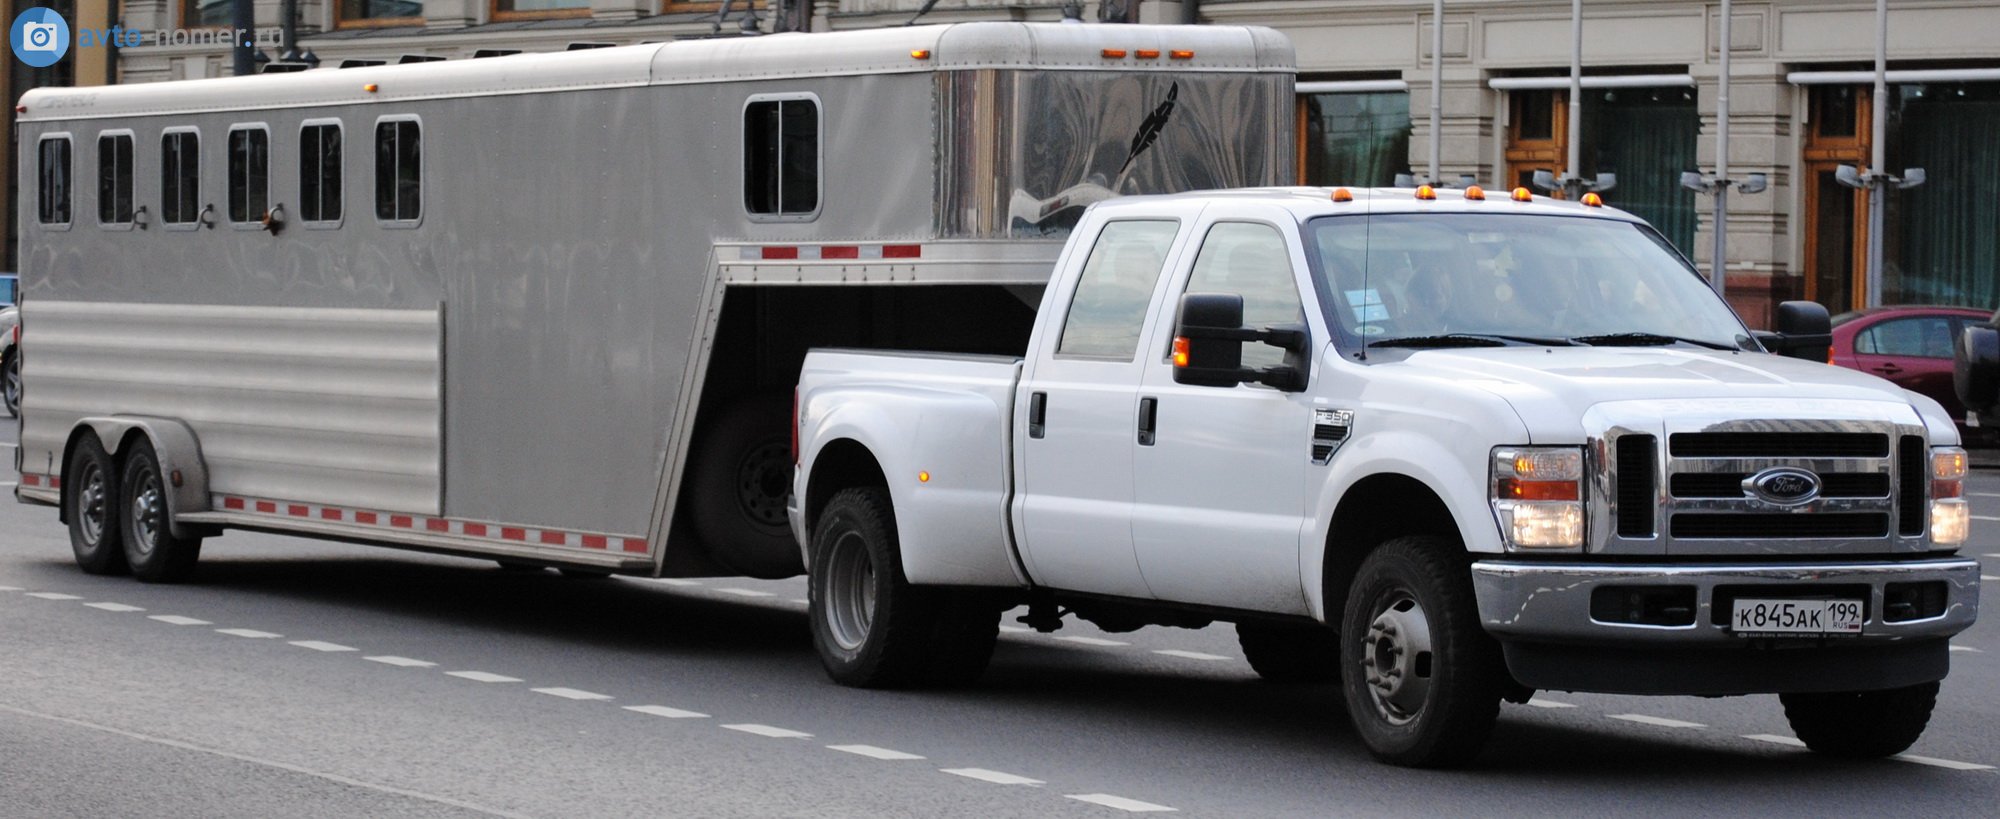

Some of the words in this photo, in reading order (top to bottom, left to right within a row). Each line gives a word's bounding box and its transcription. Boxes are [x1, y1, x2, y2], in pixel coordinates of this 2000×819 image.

[1772, 476, 1804, 493] Ford
[1828, 603, 1857, 622] 199
[1832, 621, 1848, 629] RUS
